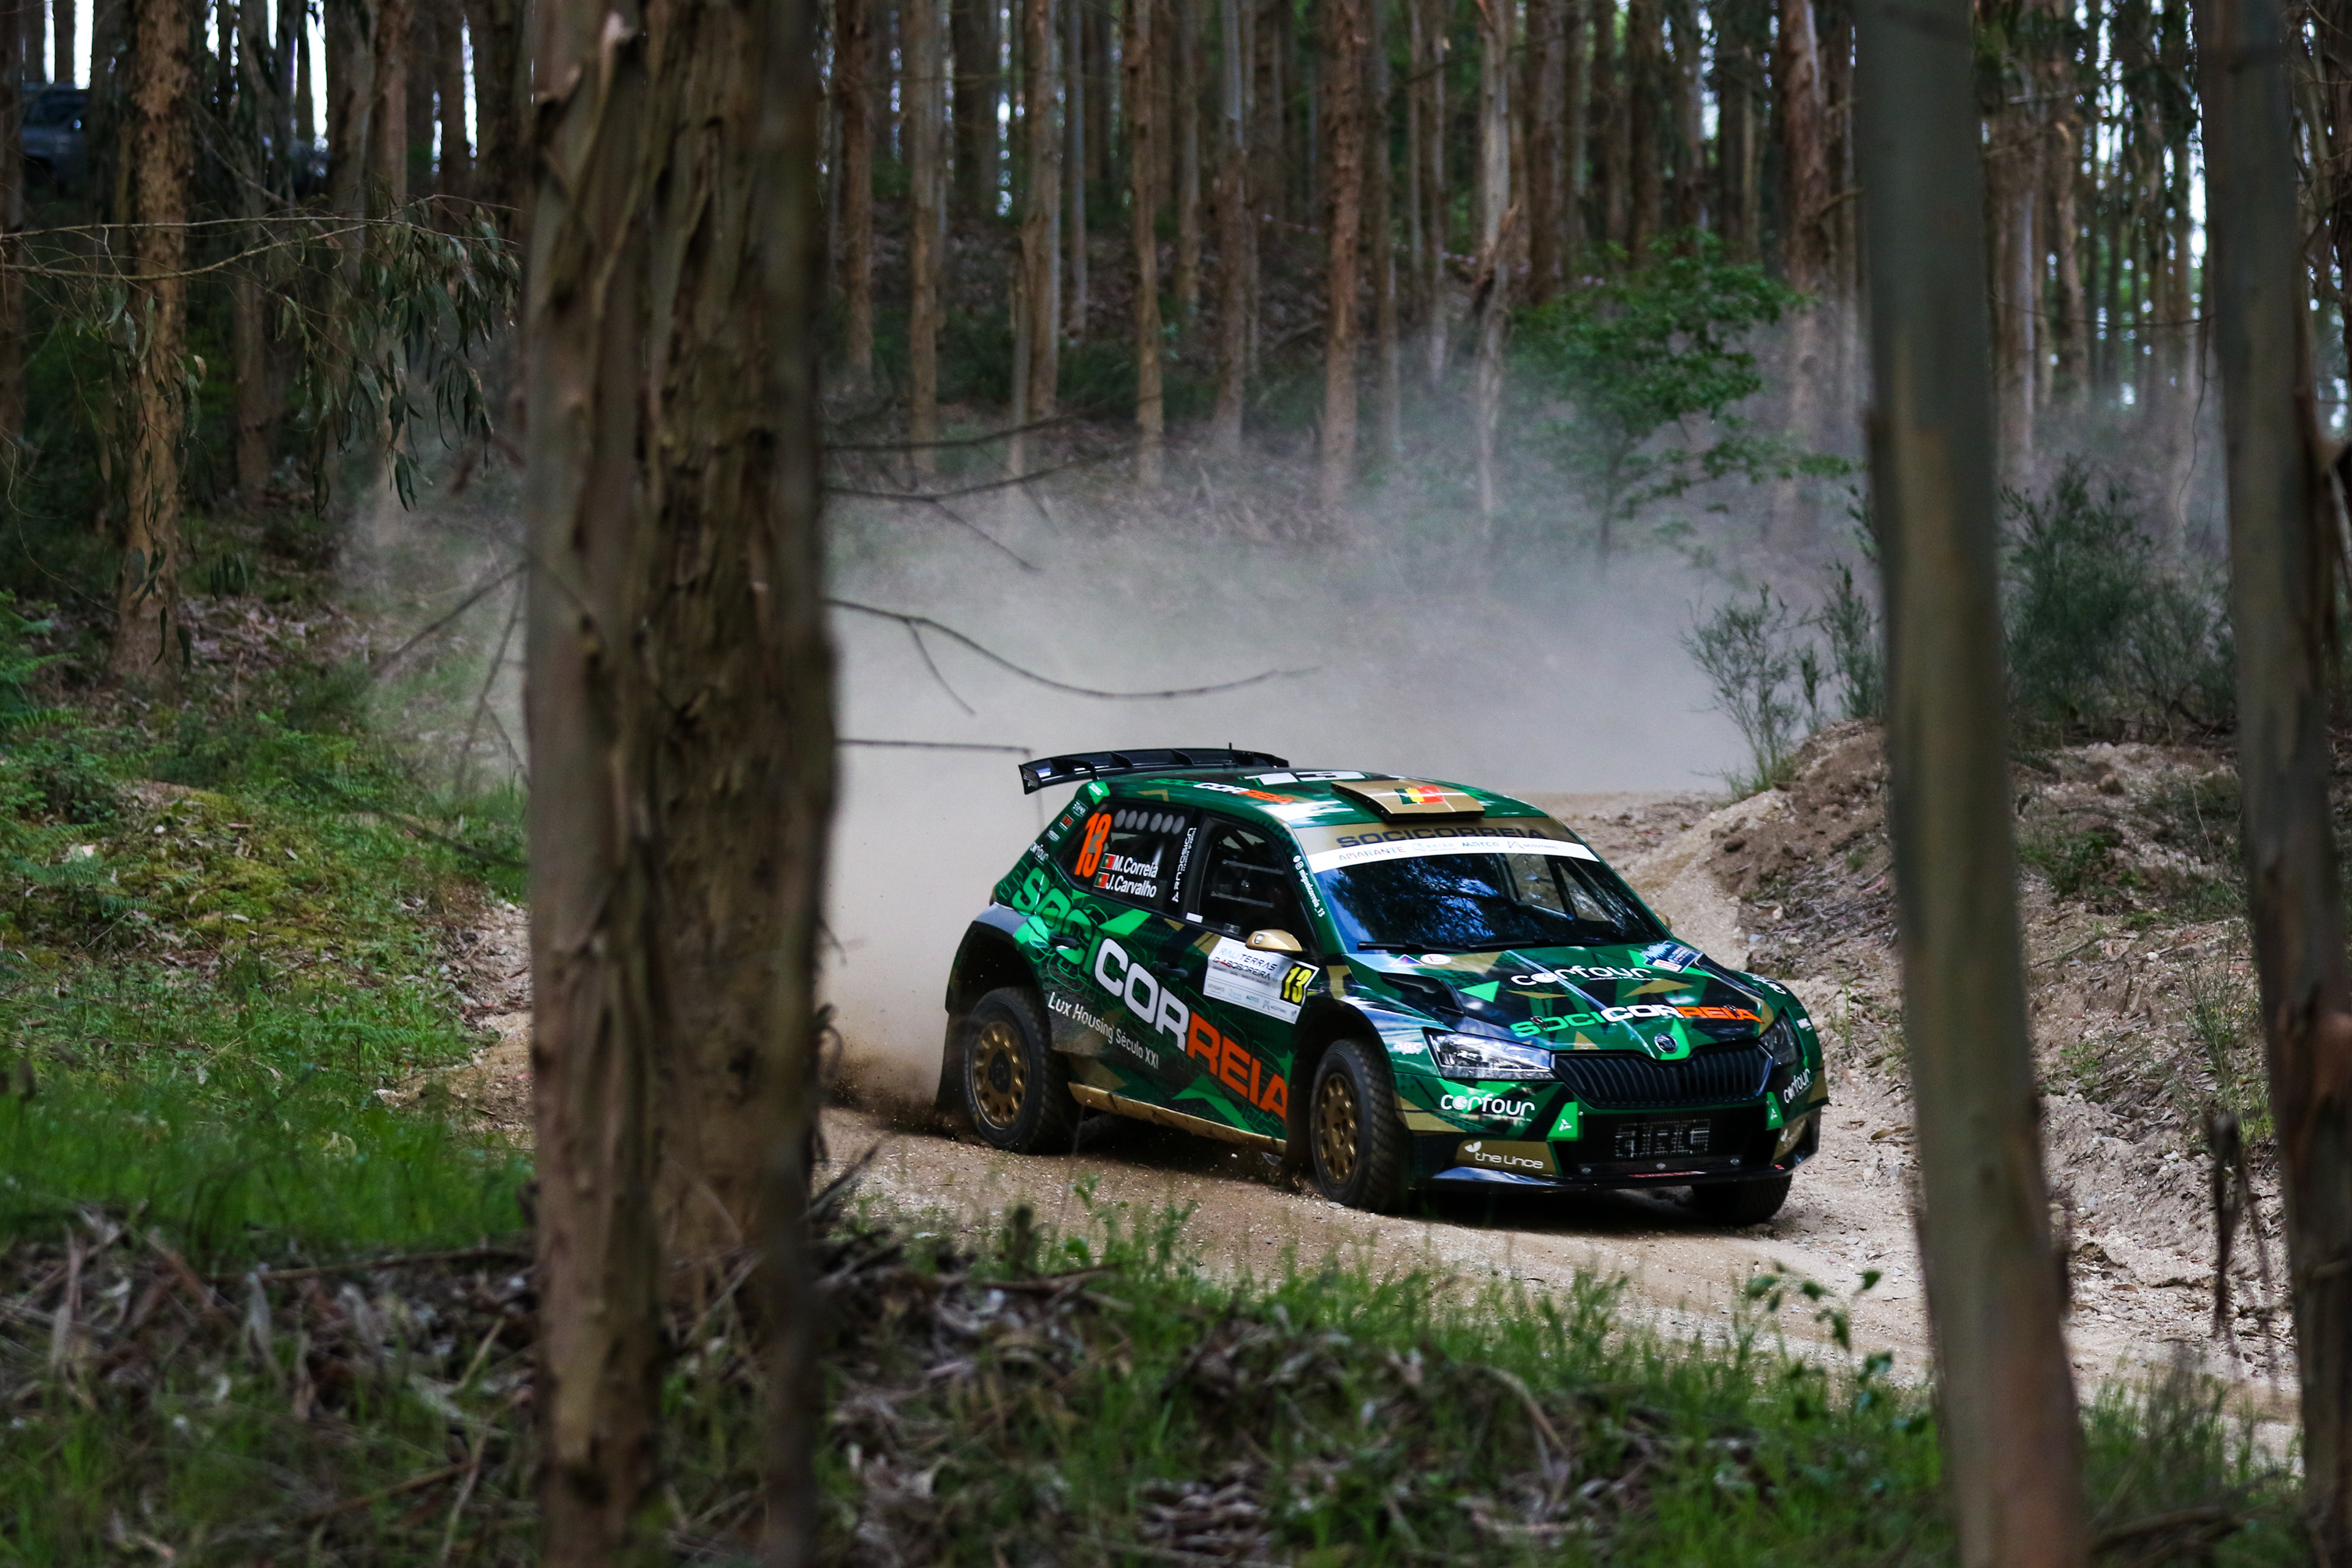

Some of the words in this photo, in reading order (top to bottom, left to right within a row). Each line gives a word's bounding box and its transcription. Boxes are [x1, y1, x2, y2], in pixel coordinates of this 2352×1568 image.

[1074, 813, 1112, 878] 13
[1339, 846, 1406, 861] AMARANTE
[1112, 855, 1159, 878] M.Correia
[1105, 875, 1158, 898] J.Carvalho
[1240, 954, 1278, 971] TERRAS
[1283, 966, 1312, 1003] 13
[1048, 992, 1072, 1017] Lux
[1072, 1003, 1114, 1044] Housing
[1115, 1028, 1144, 1059] Século
[1144, 1046, 1159, 1069] XXI
[1509, 1005, 1765, 1038] SOCICORREIA
[1475, 1152, 1502, 1163] the
